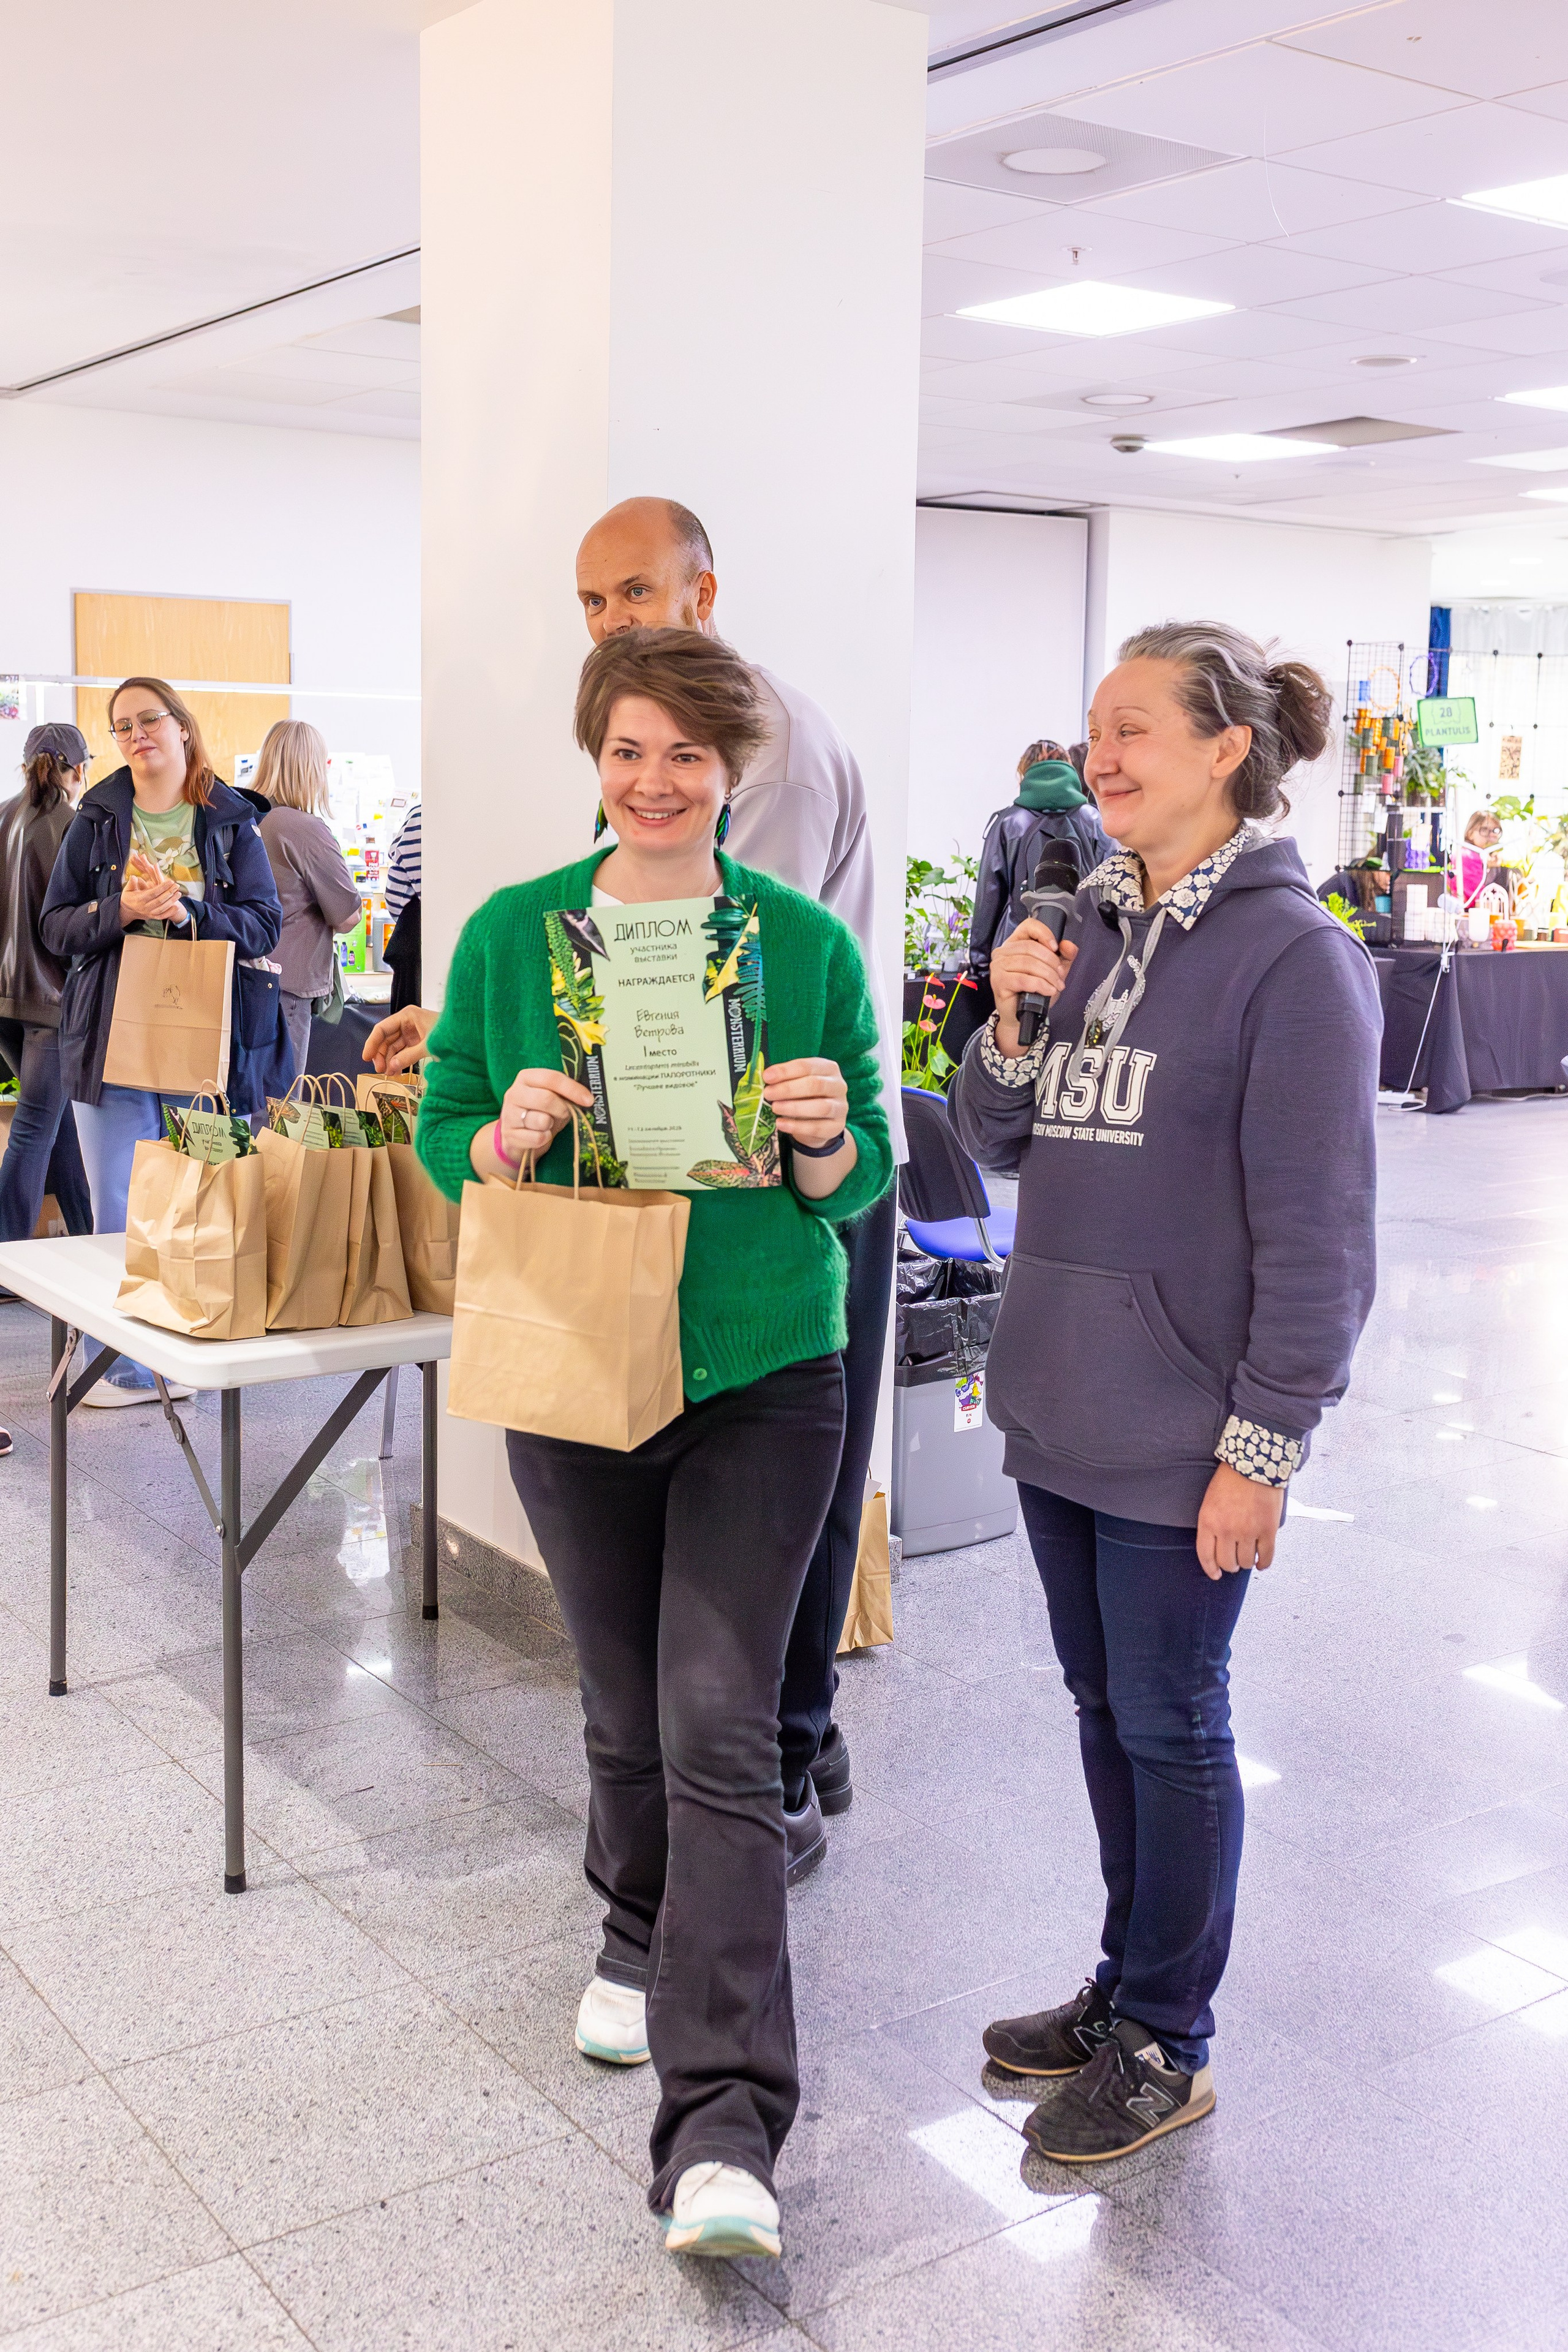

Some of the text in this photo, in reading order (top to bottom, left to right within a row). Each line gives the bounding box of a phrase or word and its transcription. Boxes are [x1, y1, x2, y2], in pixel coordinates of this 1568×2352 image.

[1440, 707, 1452, 718] 28
[614, 918, 692, 941] ДИПЛОМ
[630, 943, 677, 955] участника
[634, 954, 677, 963] выставки
[618, 973, 695, 987] НАГРАЖДАЕТСЯ
[728, 997, 747, 1072] MONSTERRIUM
[1035, 1042, 1157, 1126] MSU
[1044, 1125, 1072, 1139] MOSCOW
[1072, 1127, 1095, 1141] STATE
[1095, 1128, 1144, 1147] UNIVERSITY
